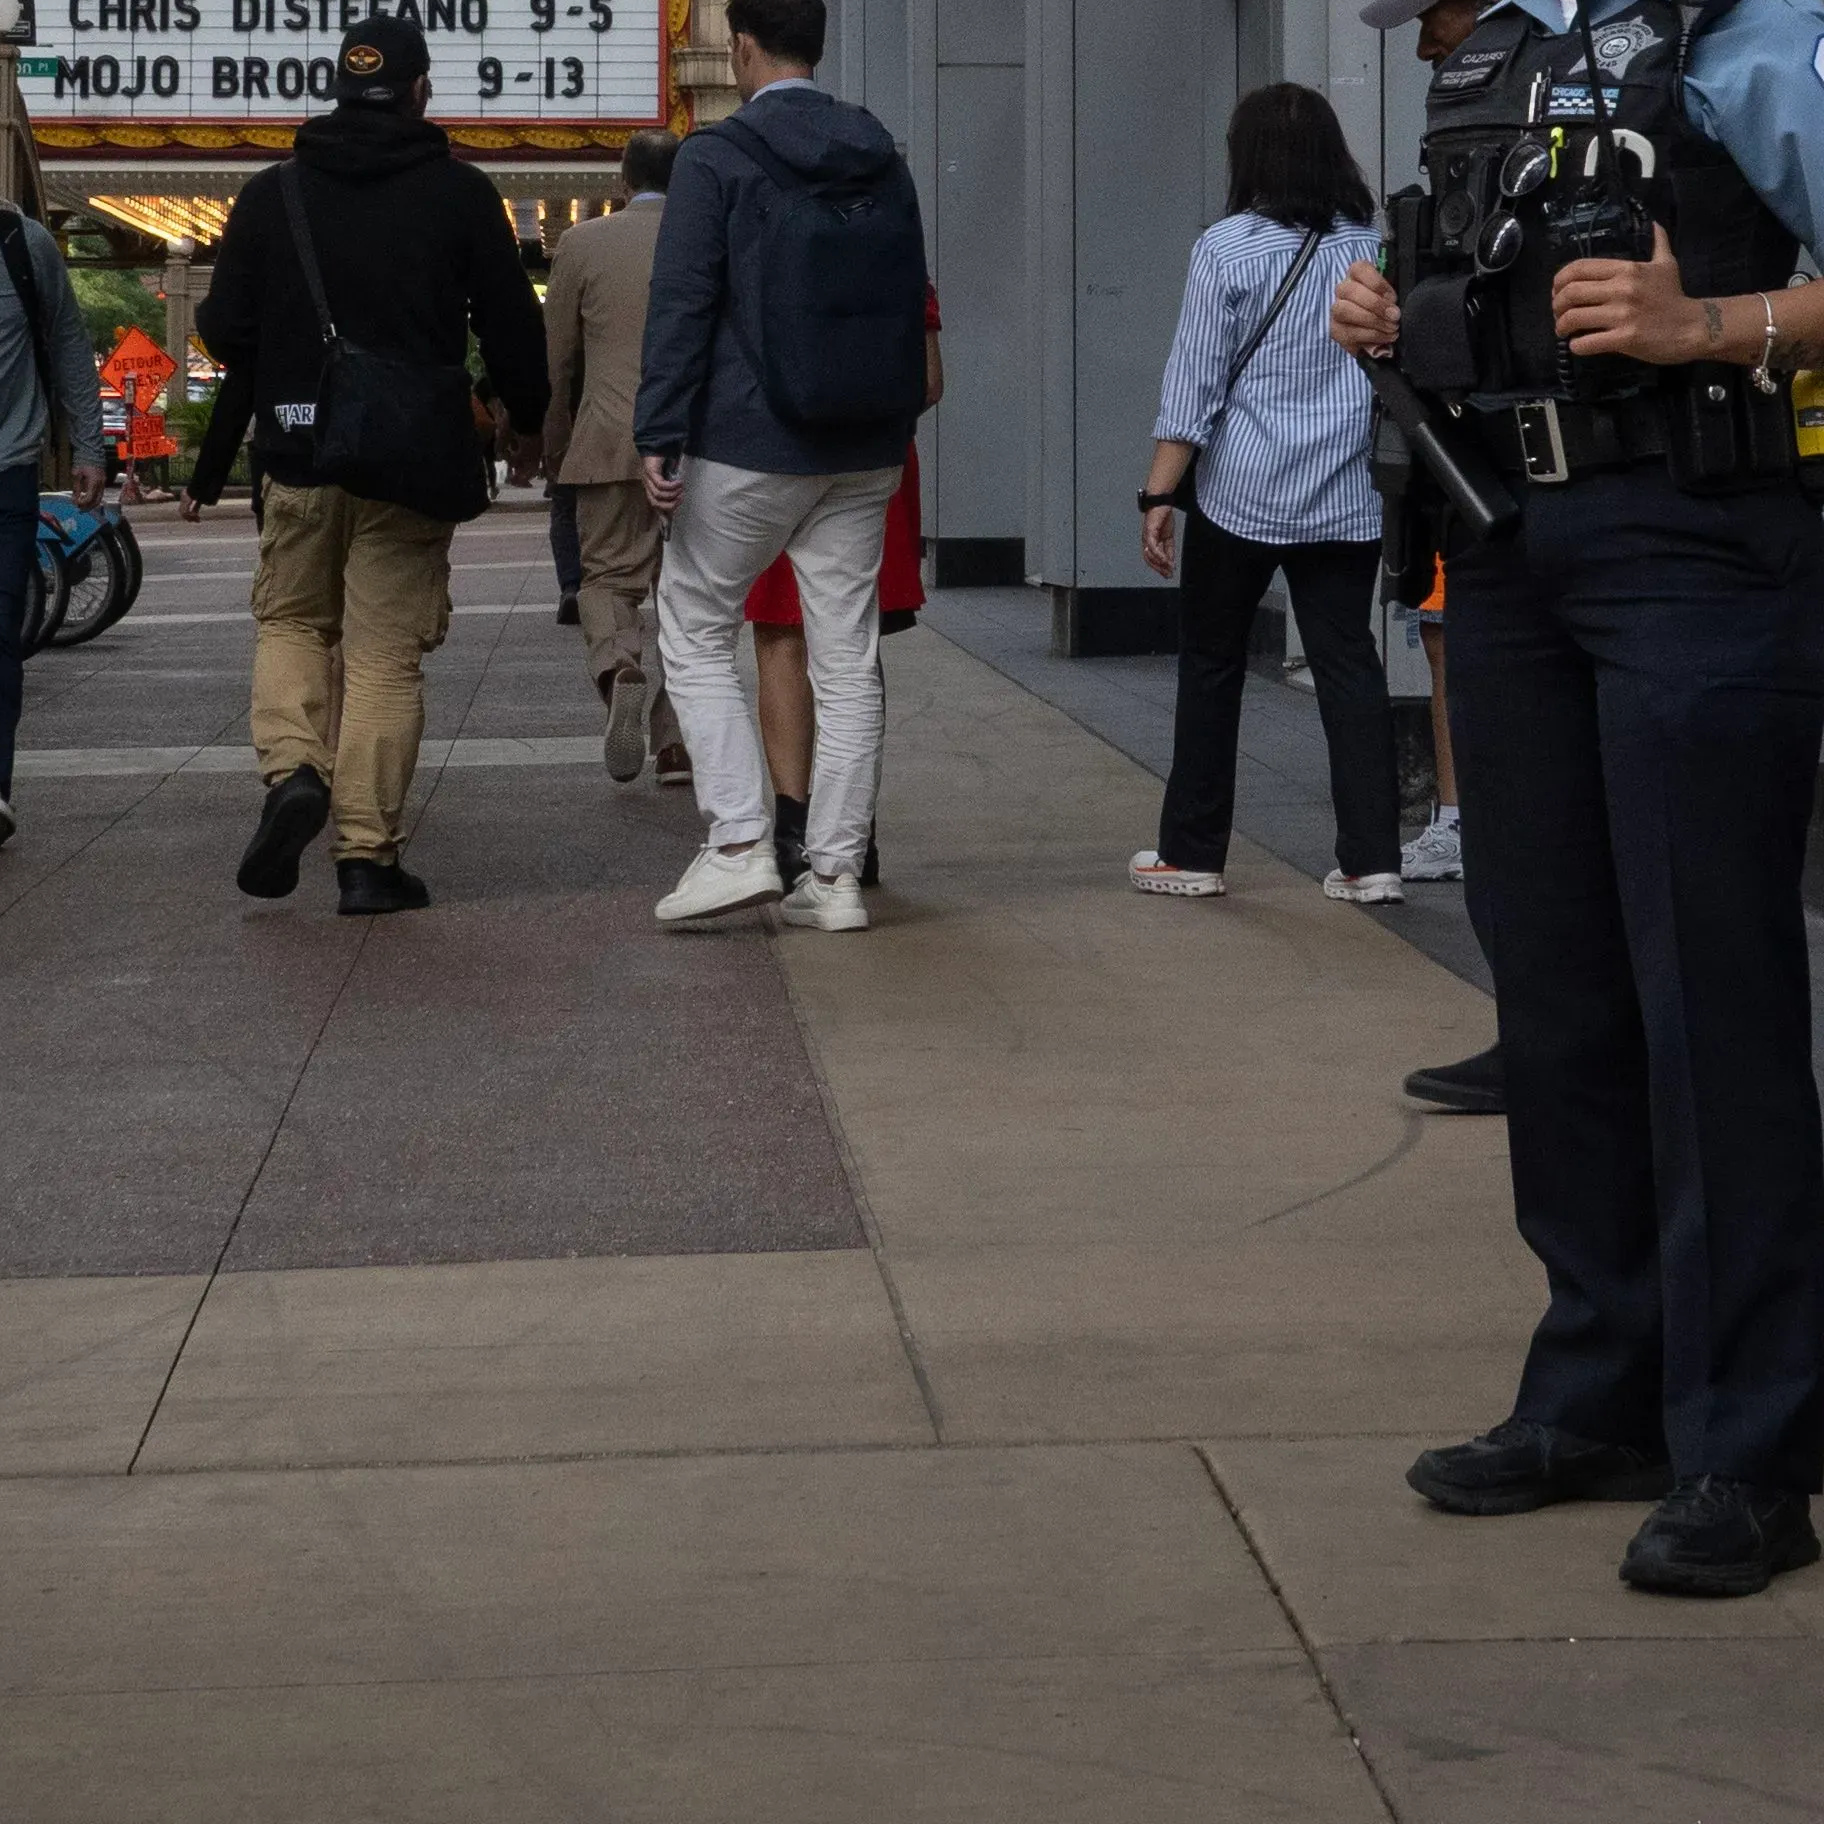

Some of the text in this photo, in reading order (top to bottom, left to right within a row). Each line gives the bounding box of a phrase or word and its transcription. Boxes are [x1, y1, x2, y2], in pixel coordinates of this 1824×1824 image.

[54, 54, 585, 100] MOJO BROO 9-13
[114, 355, 164, 372] DETOUR
